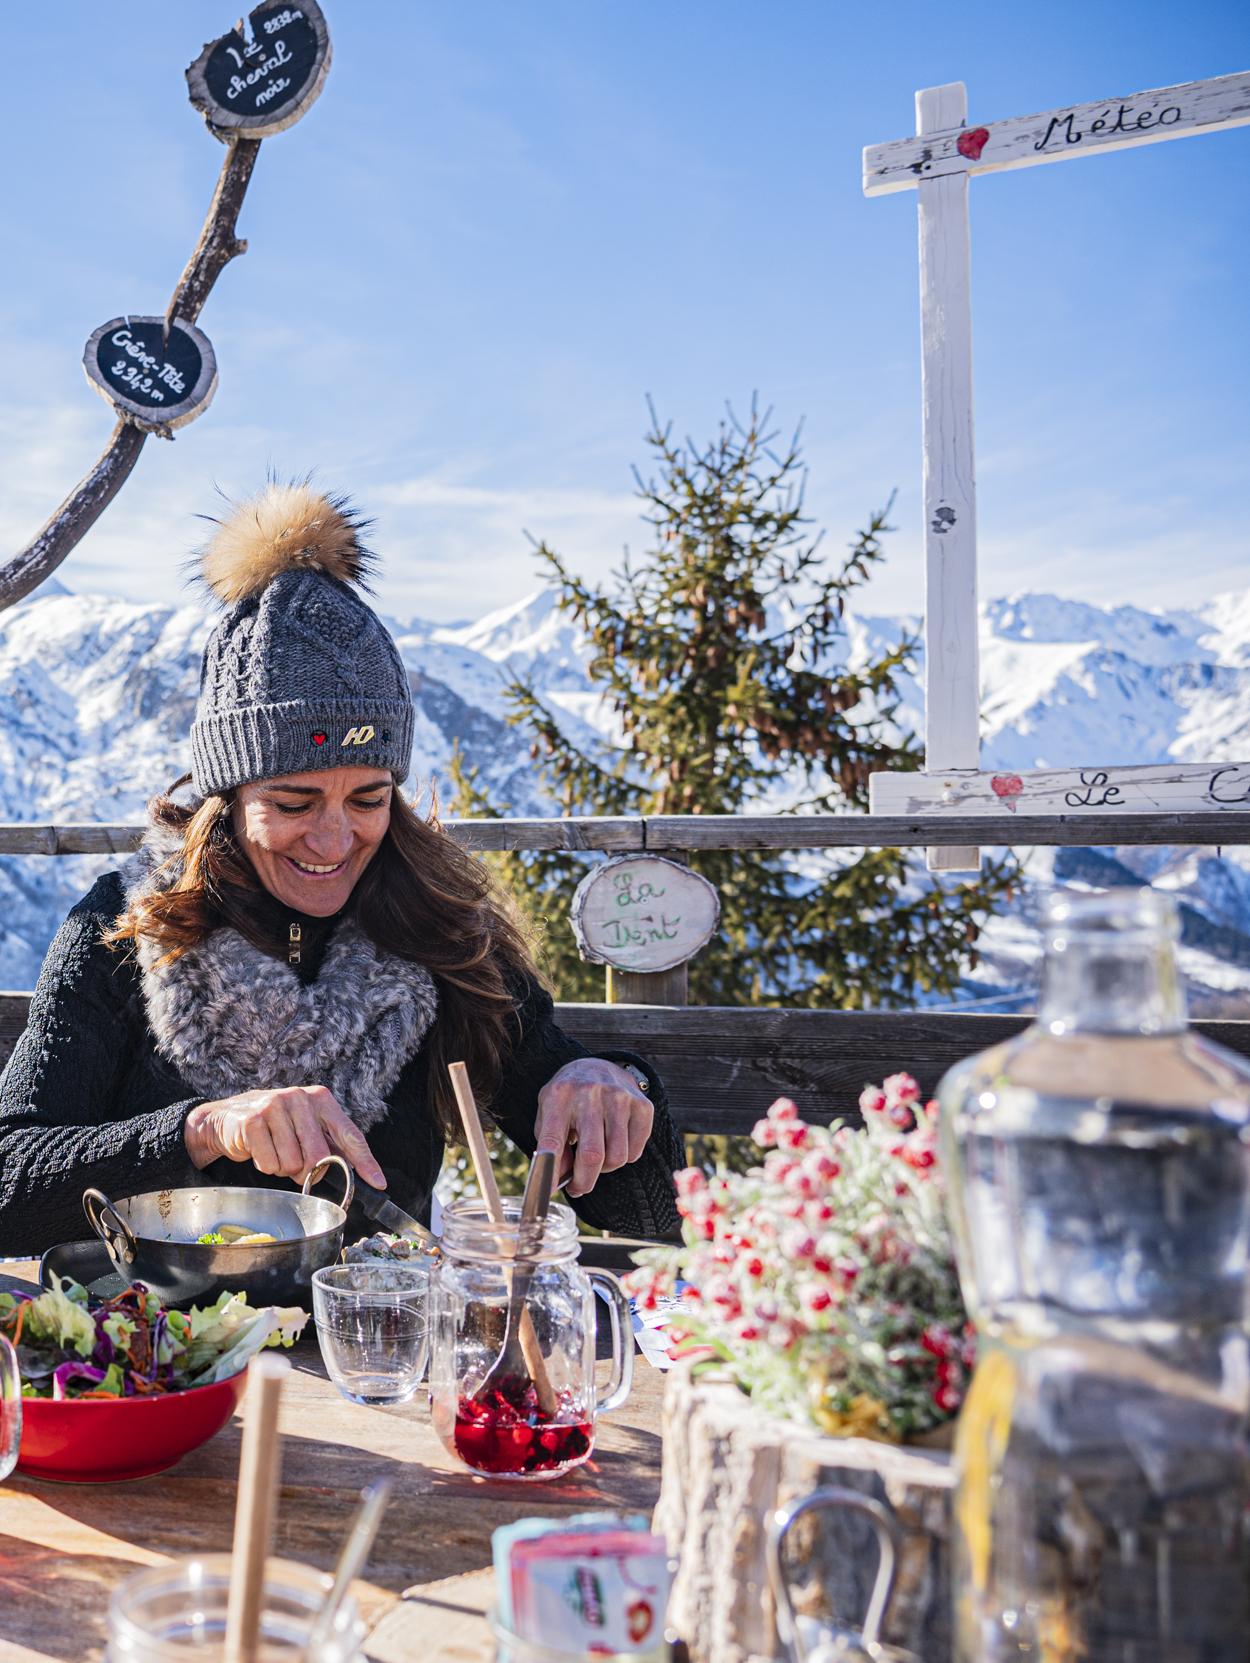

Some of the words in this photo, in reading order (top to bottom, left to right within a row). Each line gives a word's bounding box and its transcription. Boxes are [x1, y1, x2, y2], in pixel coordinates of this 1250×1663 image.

[226, 39, 293, 99] cheval
[254, 77, 291, 107] noir
[1033, 104, 1182, 152] Météo
[1064, 771, 1126, 807] Le
[613, 871, 666, 907] La
